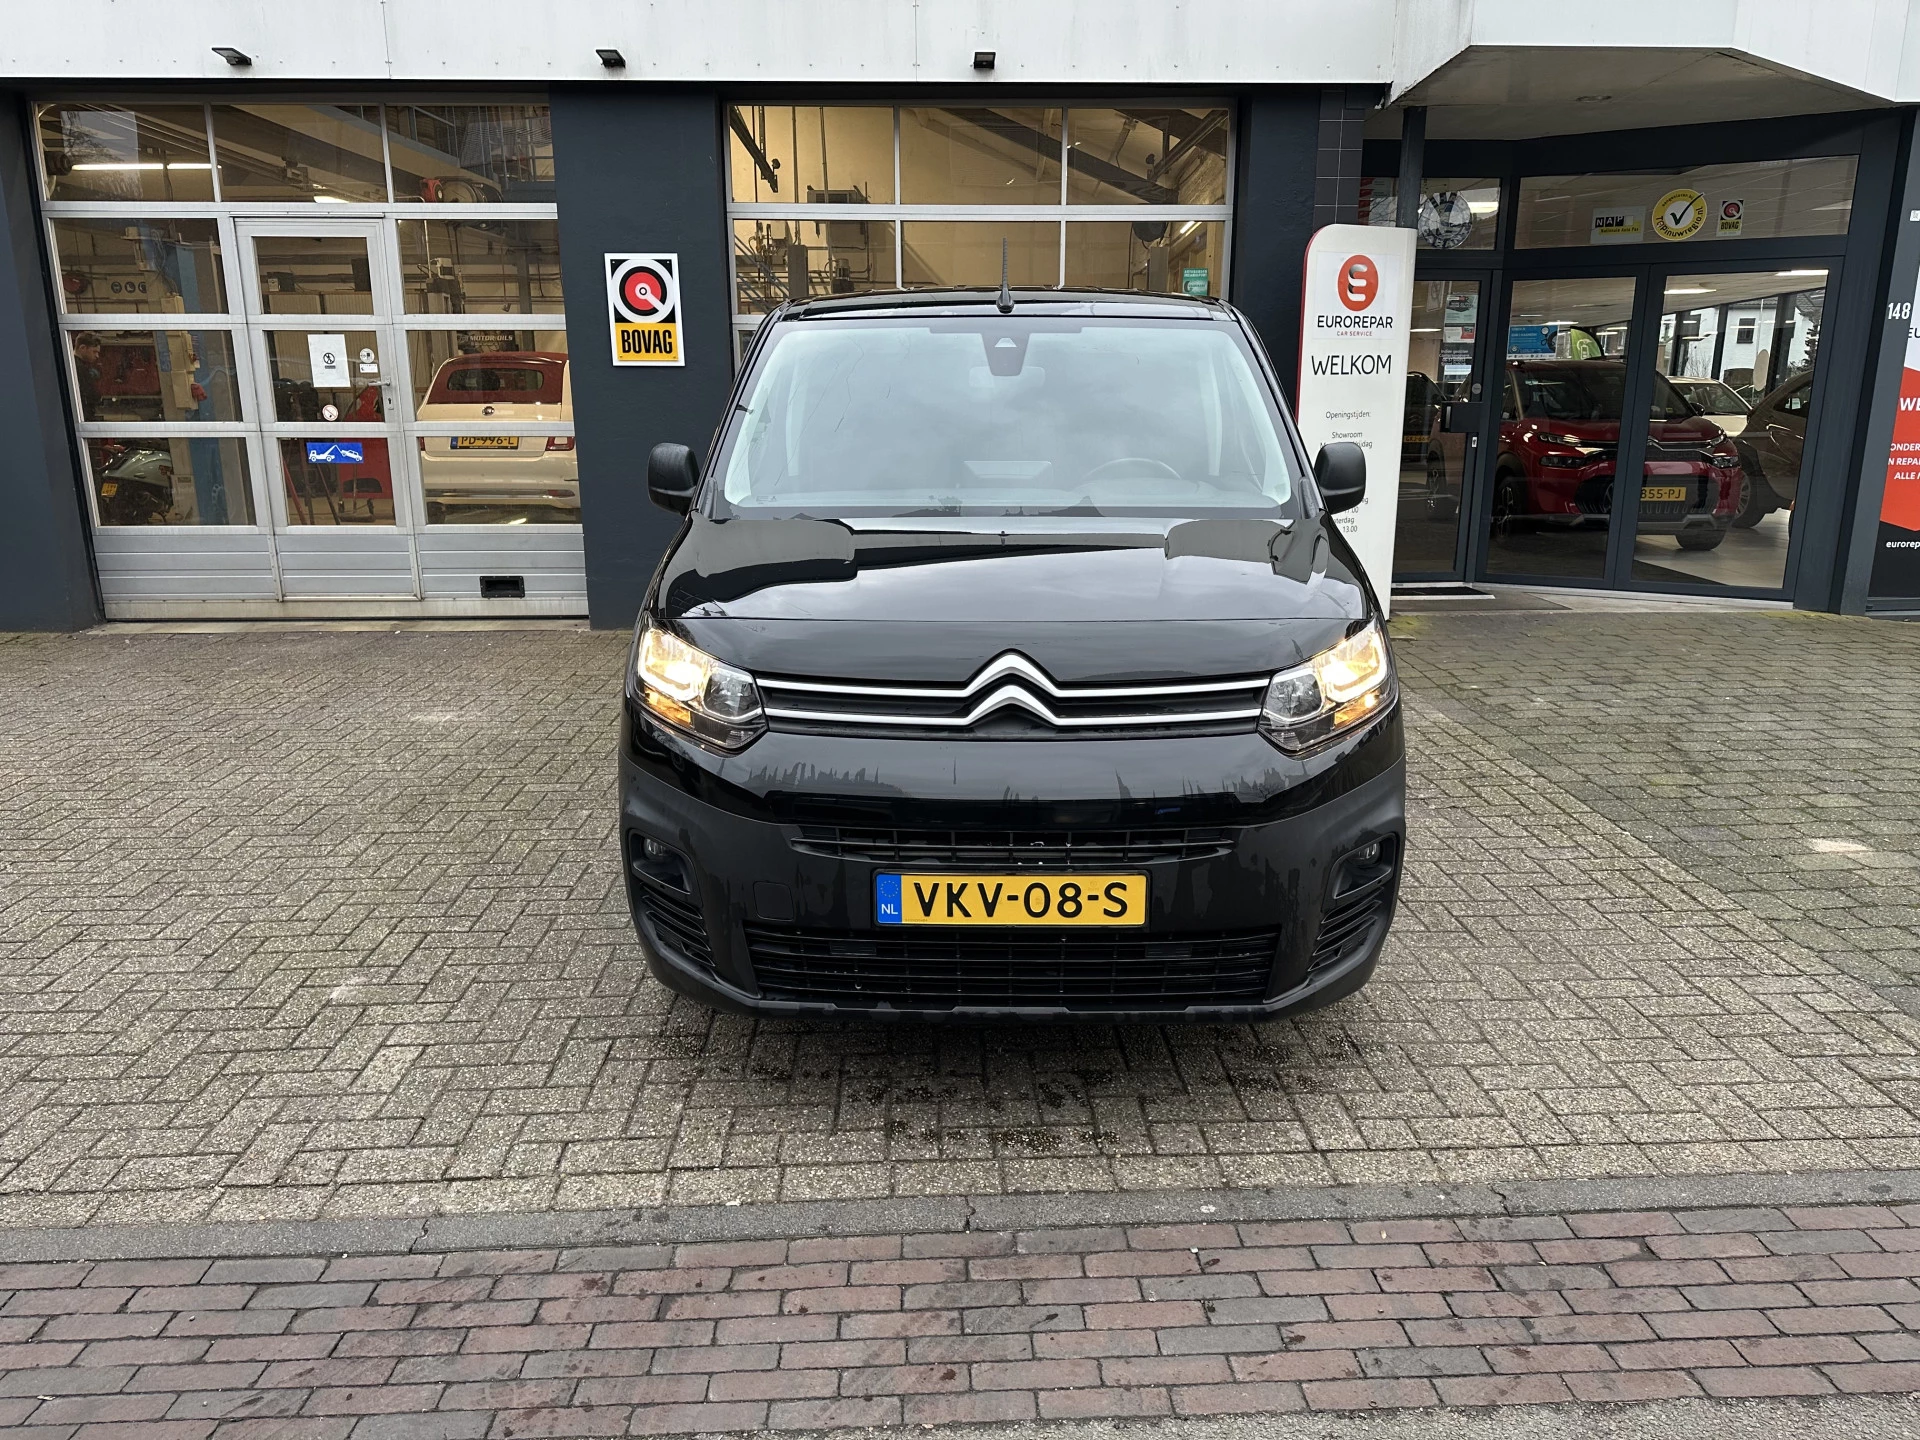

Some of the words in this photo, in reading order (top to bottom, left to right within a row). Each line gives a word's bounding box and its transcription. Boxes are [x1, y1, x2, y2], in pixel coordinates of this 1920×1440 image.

[1596, 216, 1624, 227] NAP
[1721, 220, 1740, 230] BOVAG
[1888, 303, 1911, 320] 148
[1317, 315, 1394, 329] EUROREPAR
[620, 329, 673, 355] BOVAG
[1311, 354, 1392, 376] WELKOM
[461, 436, 515, 445] PD-996-L
[1331, 431, 1363, 439] Showroom
[913, 882, 1128, 918] VKV-08-S
[881, 903, 899, 914] NL
